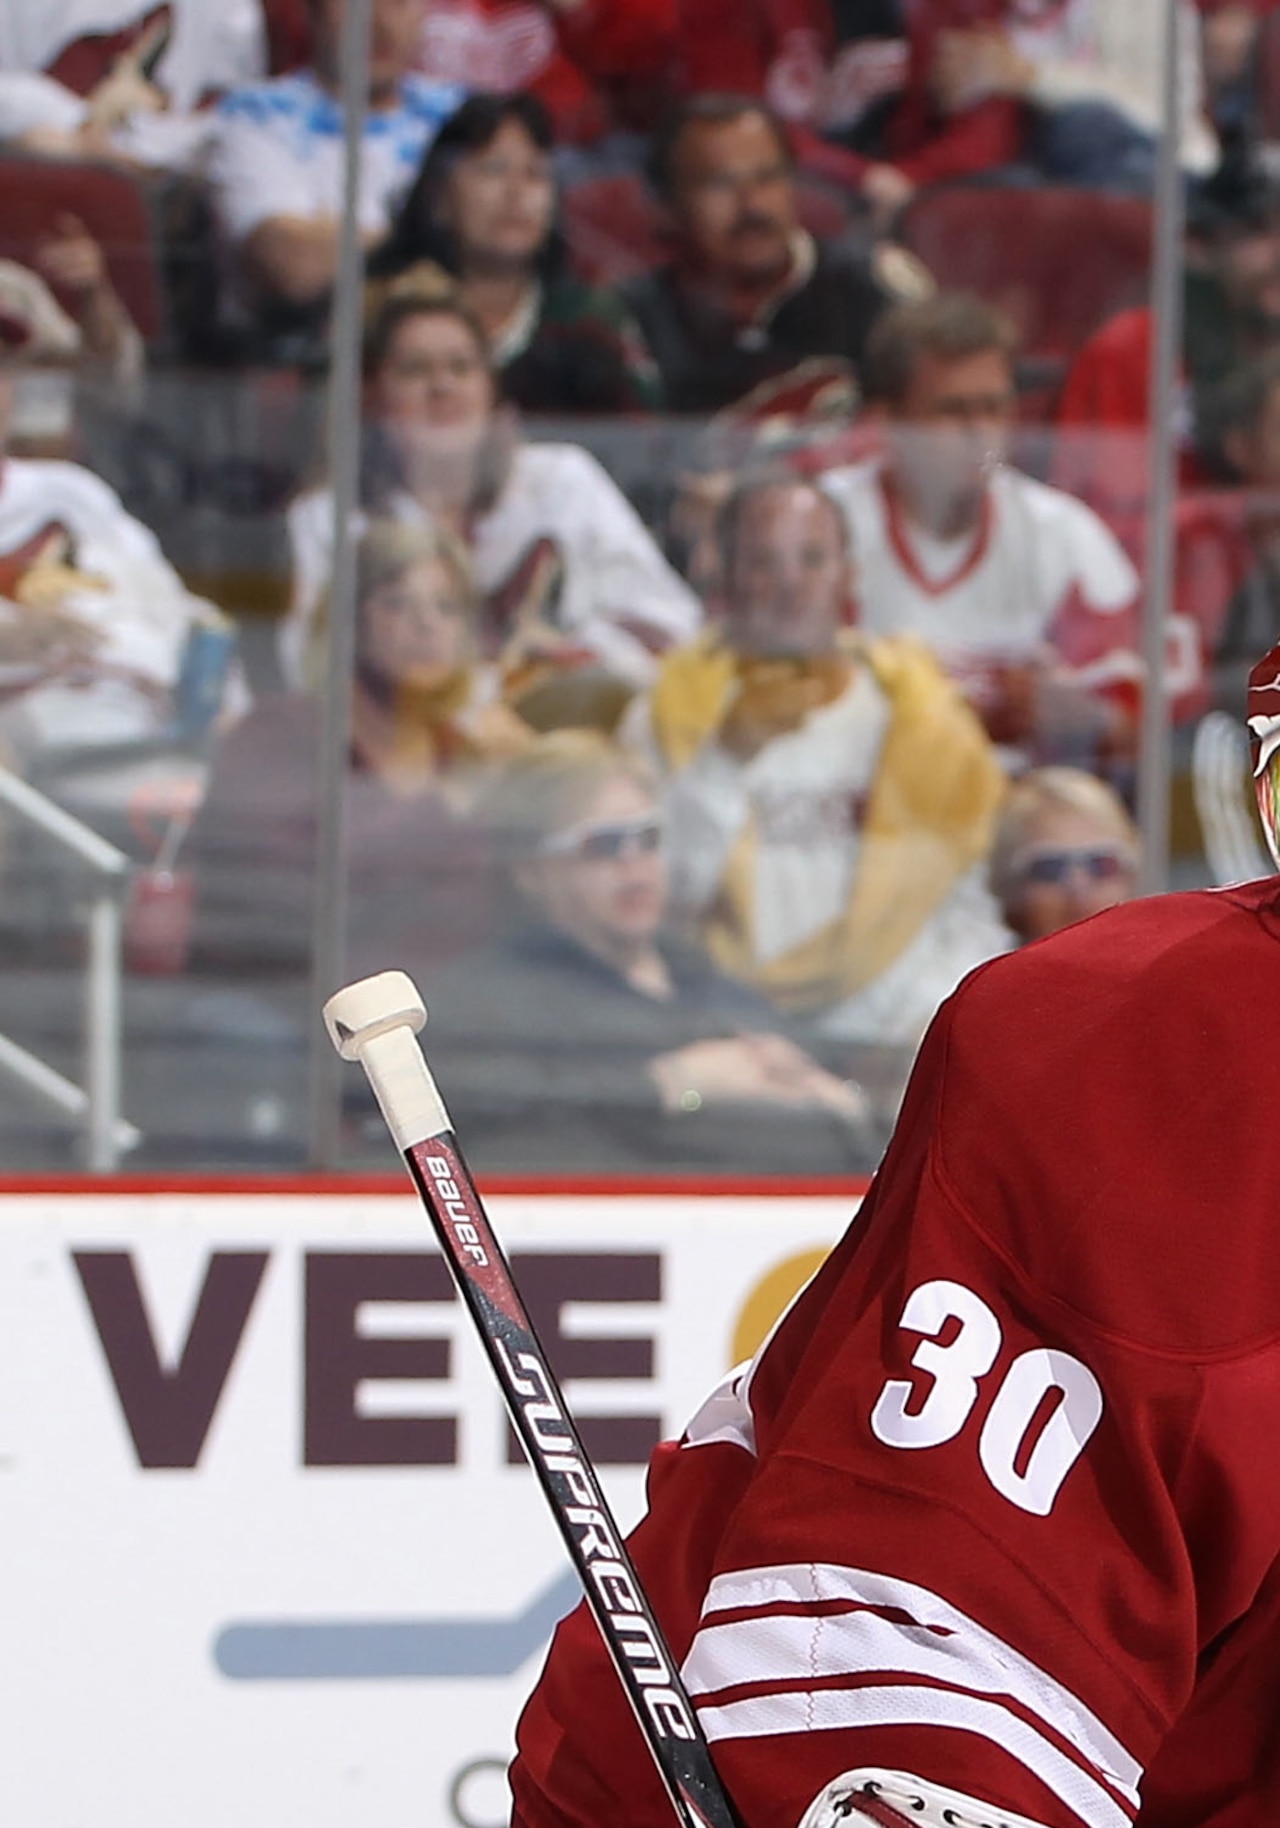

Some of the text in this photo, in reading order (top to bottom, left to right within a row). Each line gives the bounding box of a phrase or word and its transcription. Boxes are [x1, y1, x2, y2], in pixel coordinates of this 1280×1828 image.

[426, 1156, 488, 1267] BAUER
[871, 1280, 1102, 1516] 30
[495, 1337, 697, 1742] SUPREME
